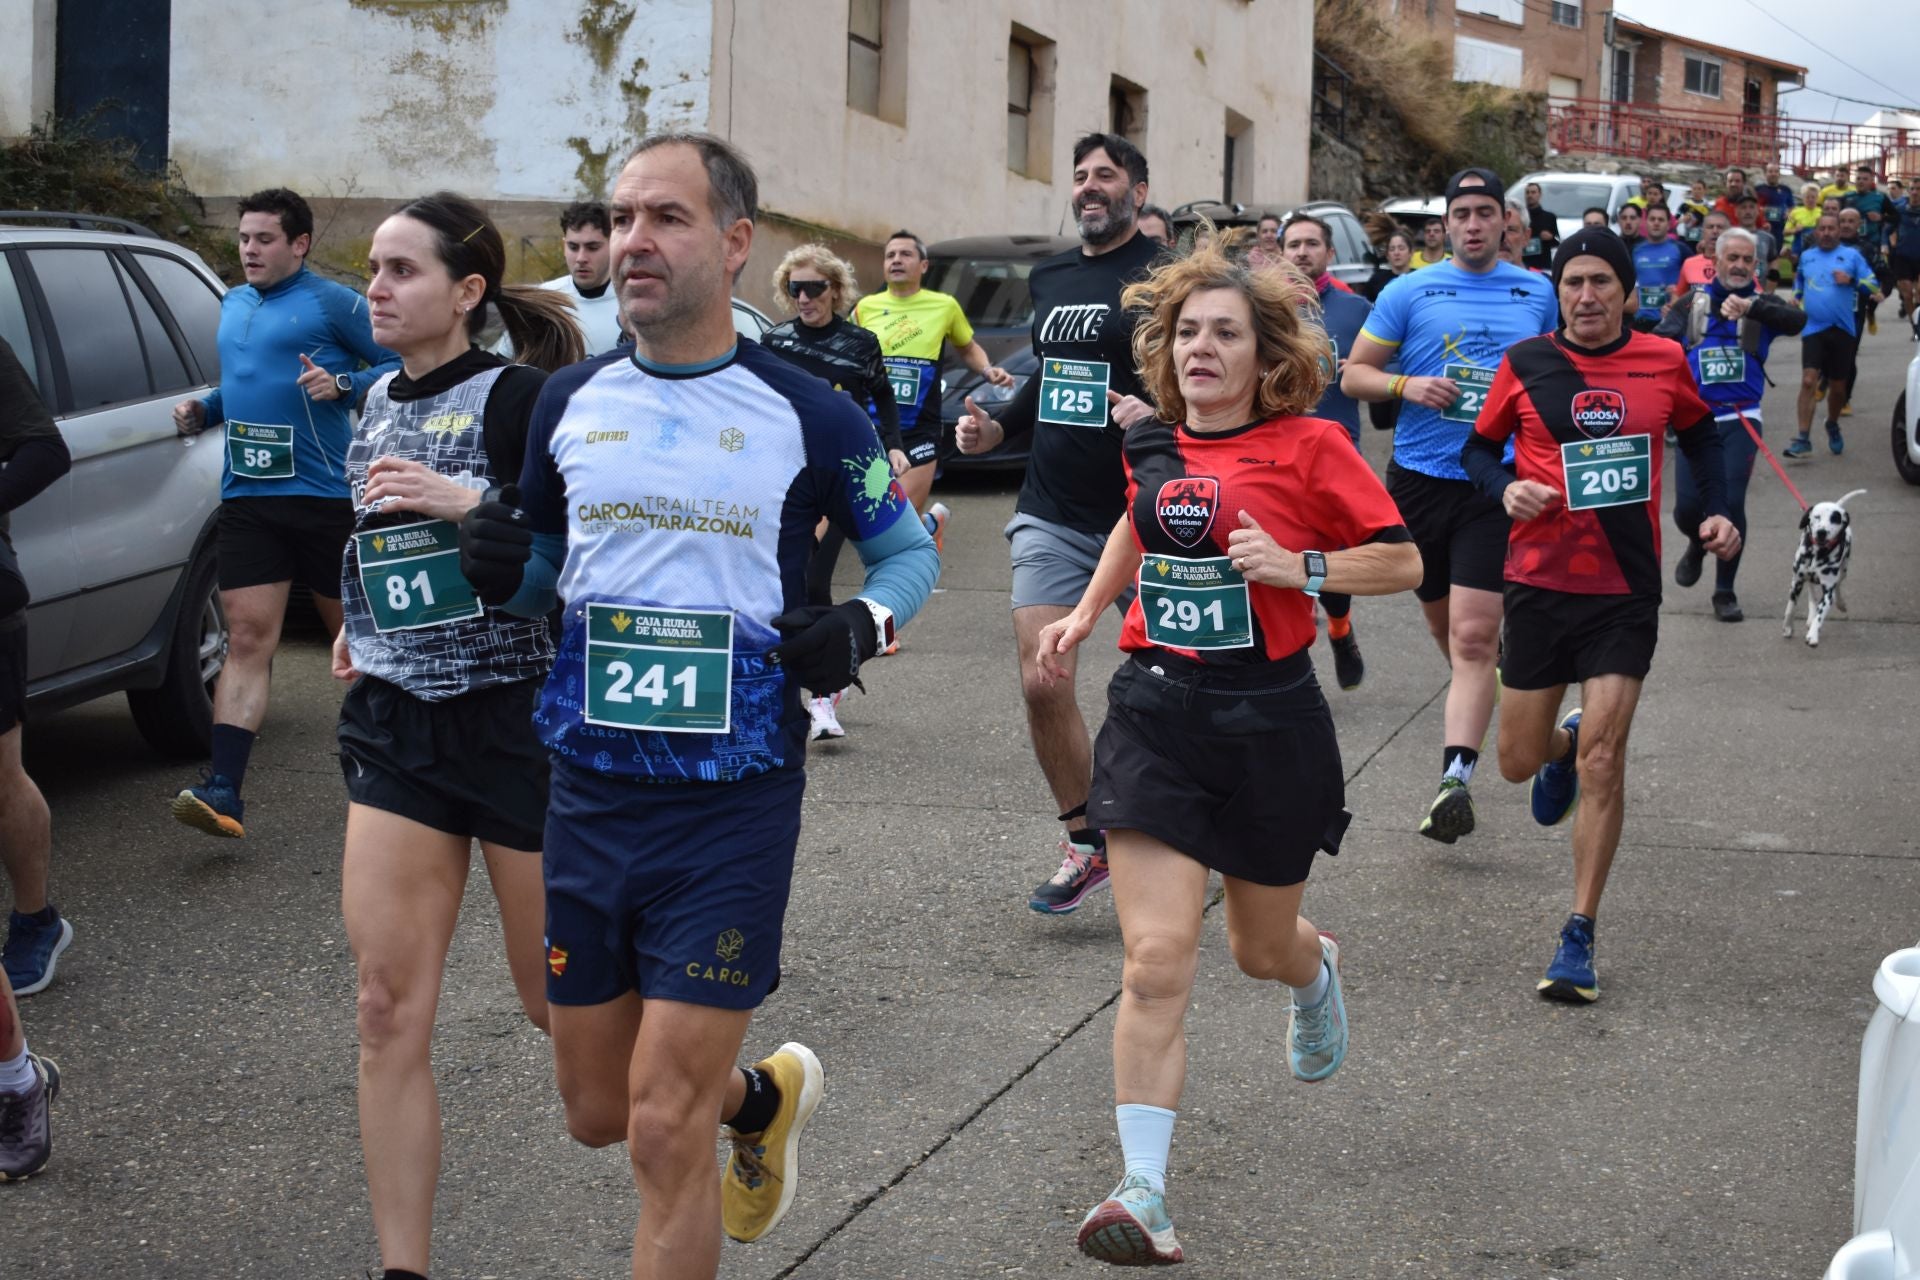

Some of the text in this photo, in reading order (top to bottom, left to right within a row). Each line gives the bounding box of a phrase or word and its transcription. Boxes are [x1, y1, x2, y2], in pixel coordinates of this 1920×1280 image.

[1040, 304, 1111, 344] NIKE
[1706, 362, 1738, 376] 207
[1049, 388, 1094, 413] 125
[1576, 410, 1619, 420] LODOSA
[244, 448, 272, 468] 58
[1580, 466, 1638, 495] 205
[1160, 504, 1209, 517] LODOSA
[578, 502, 753, 539] CAROA TARAZONA
[1169, 518, 1202, 526] Atletismo
[387, 529, 432, 544] CAJA RURAL
[387, 543, 398, 552] DE
[398, 537, 438, 550] NAVARRA
[1172, 564, 1217, 573] CAJA RURAL
[1172, 571, 1222, 580] DE NAVARRA
[386, 570, 435, 610] 81
[1157, 597, 1224, 631] 291
[635, 616, 699, 629] CAJA RURAL
[635, 626, 703, 638] DE NAVARRA
[604, 661, 697, 707] 241
[580, 727, 627, 739] CAROA
[686, 962, 749, 986] CAROA
